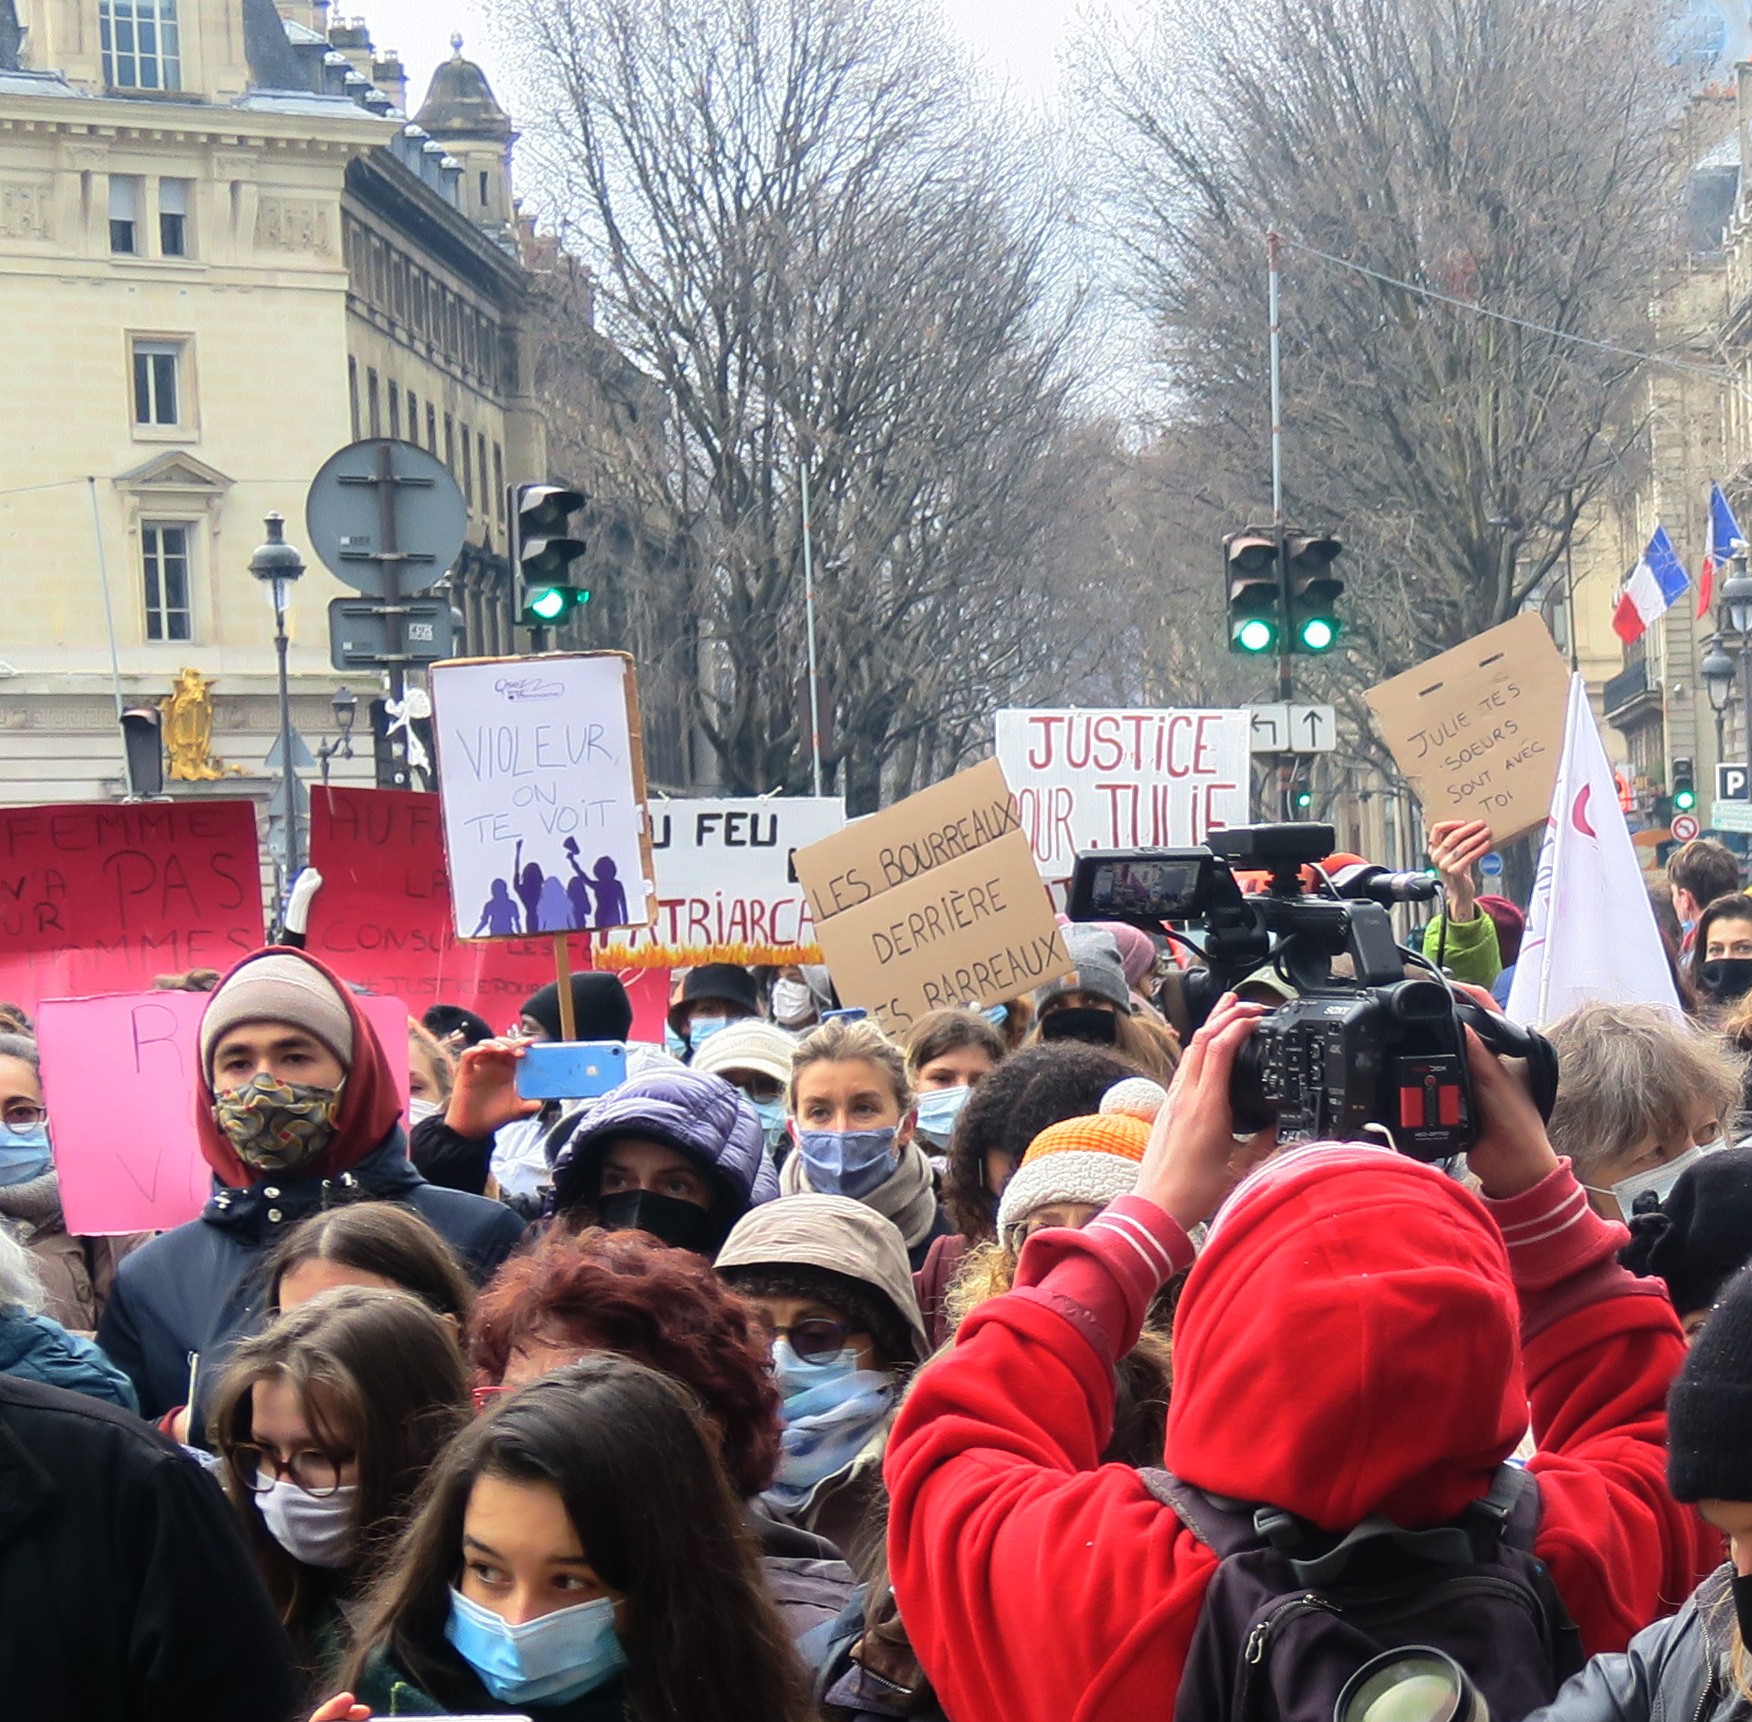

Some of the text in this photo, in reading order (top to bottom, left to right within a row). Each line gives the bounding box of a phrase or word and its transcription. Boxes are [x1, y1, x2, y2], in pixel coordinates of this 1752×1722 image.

[1406, 682, 1521, 759] JULIE TES
[512, 782, 557, 807] ON
[1446, 770, 1493, 804] SONT
[1726, 771, 1744, 796] P
[463, 812, 523, 843] TE
[696, 811, 777, 847] FEU
[811, 868, 872, 921] LES
[879, 797, 1022, 888] BOURREAUX
[101, 849, 245, 932] PAS
